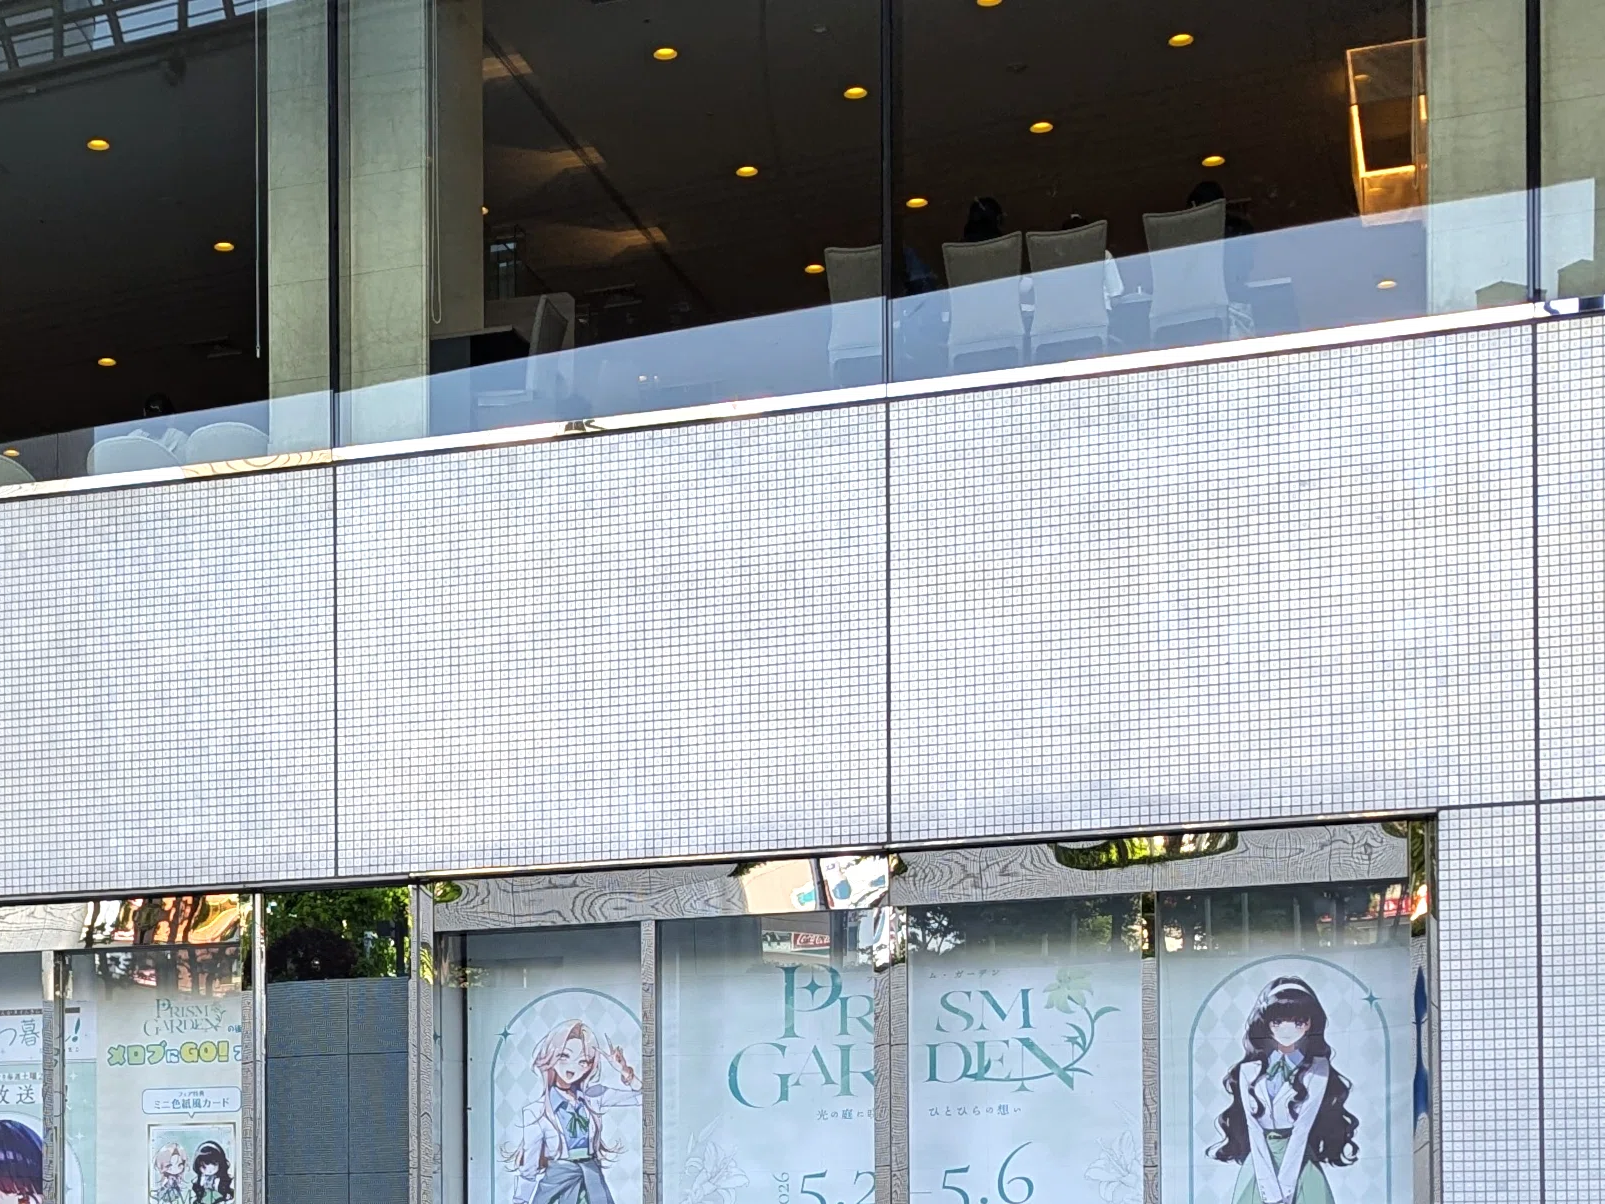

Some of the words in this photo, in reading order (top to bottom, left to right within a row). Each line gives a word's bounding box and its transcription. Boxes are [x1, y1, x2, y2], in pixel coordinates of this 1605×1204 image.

[155, 998, 208, 1018] PRISM
[143, 1019, 220, 1036] GARDEN
[154, 1098, 230, 1109] ミニ色紙風カード
